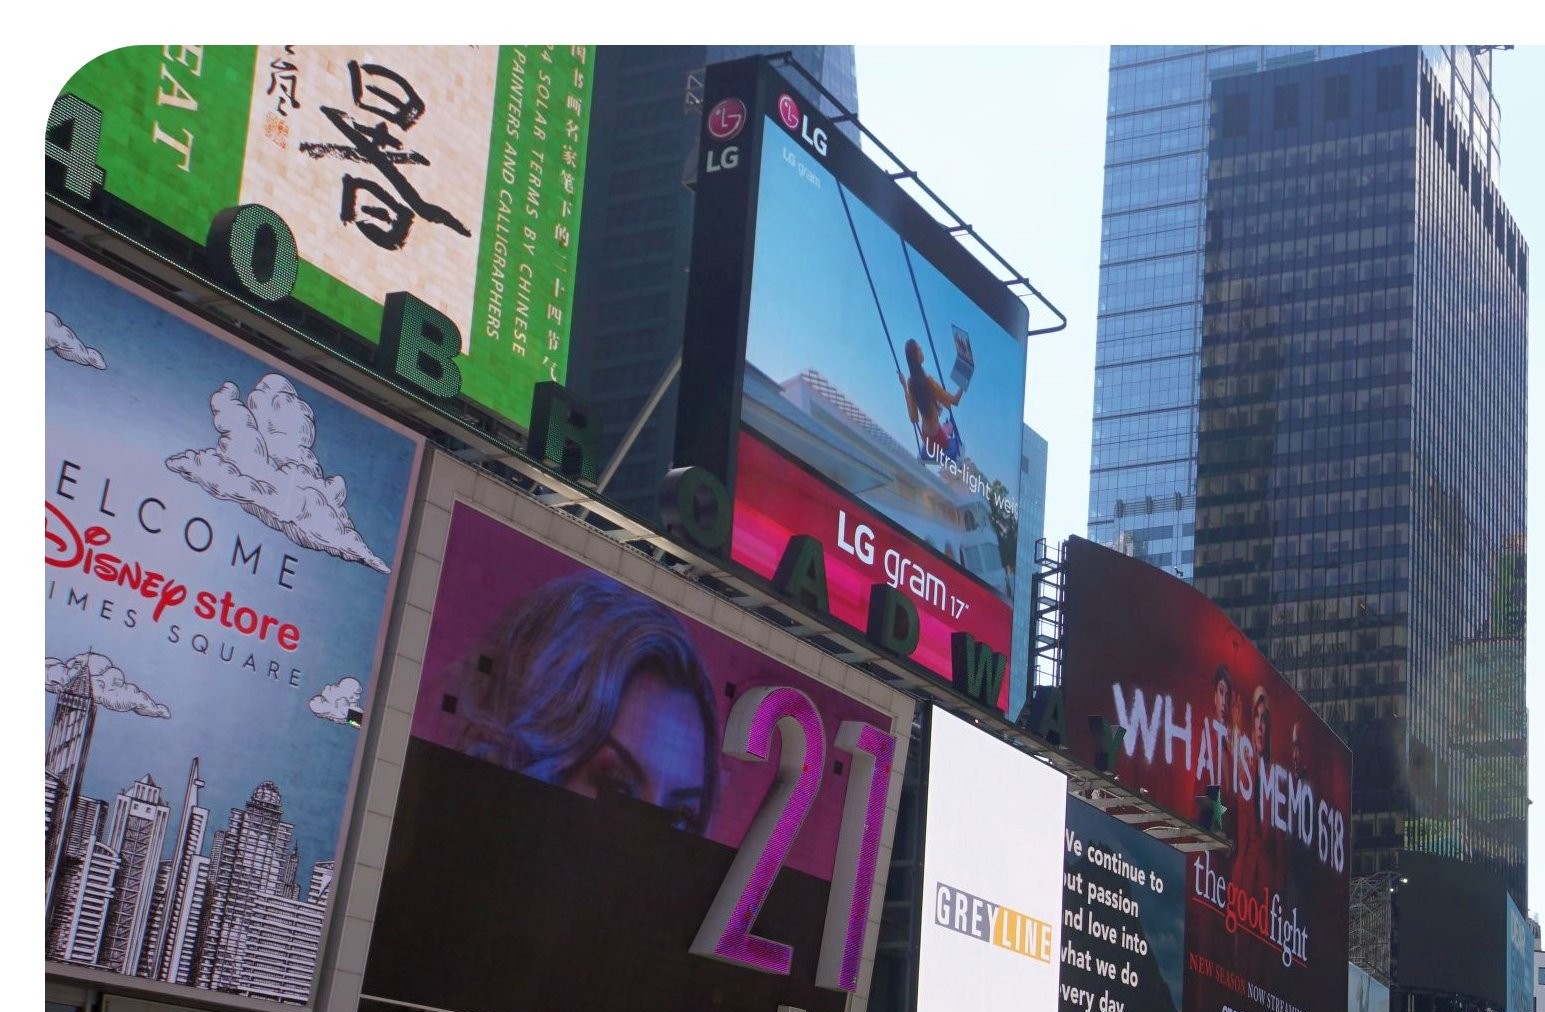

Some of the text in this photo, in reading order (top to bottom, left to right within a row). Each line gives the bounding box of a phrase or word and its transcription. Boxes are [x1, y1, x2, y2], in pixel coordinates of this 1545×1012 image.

[706, 146, 739, 173] LG
[802, 115, 828, 156] LG
[486, 48, 526, 340] PAINTERS AND CALLIGRAPHERS
[783, 147, 821, 190] LG gram
[512, 69, 551, 356] SOLAR TERMS BY CHINESE
[926, 437, 991, 501] Ultra-light
[837, 510, 875, 566] LG
[884, 548, 946, 611] gram
[194, 591, 301, 651] store
[167, 624, 302, 687] SQUARE
[1112, 682, 1345, 874] WHAT IS MEMO 618
[688, 684, 898, 992] 21
[1087, 845, 1164, 894] continue to
[937, 884, 1051, 961] GREYLINE
[1087, 882, 1139, 918] passion
[1088, 911, 1148, 956] love into
[1096, 957, 1138, 988] we do
[1190, 952, 1213, 977] NEW
[1215, 965, 1246, 994] SEASON
[1247, 981, 1266, 1004] NOW
